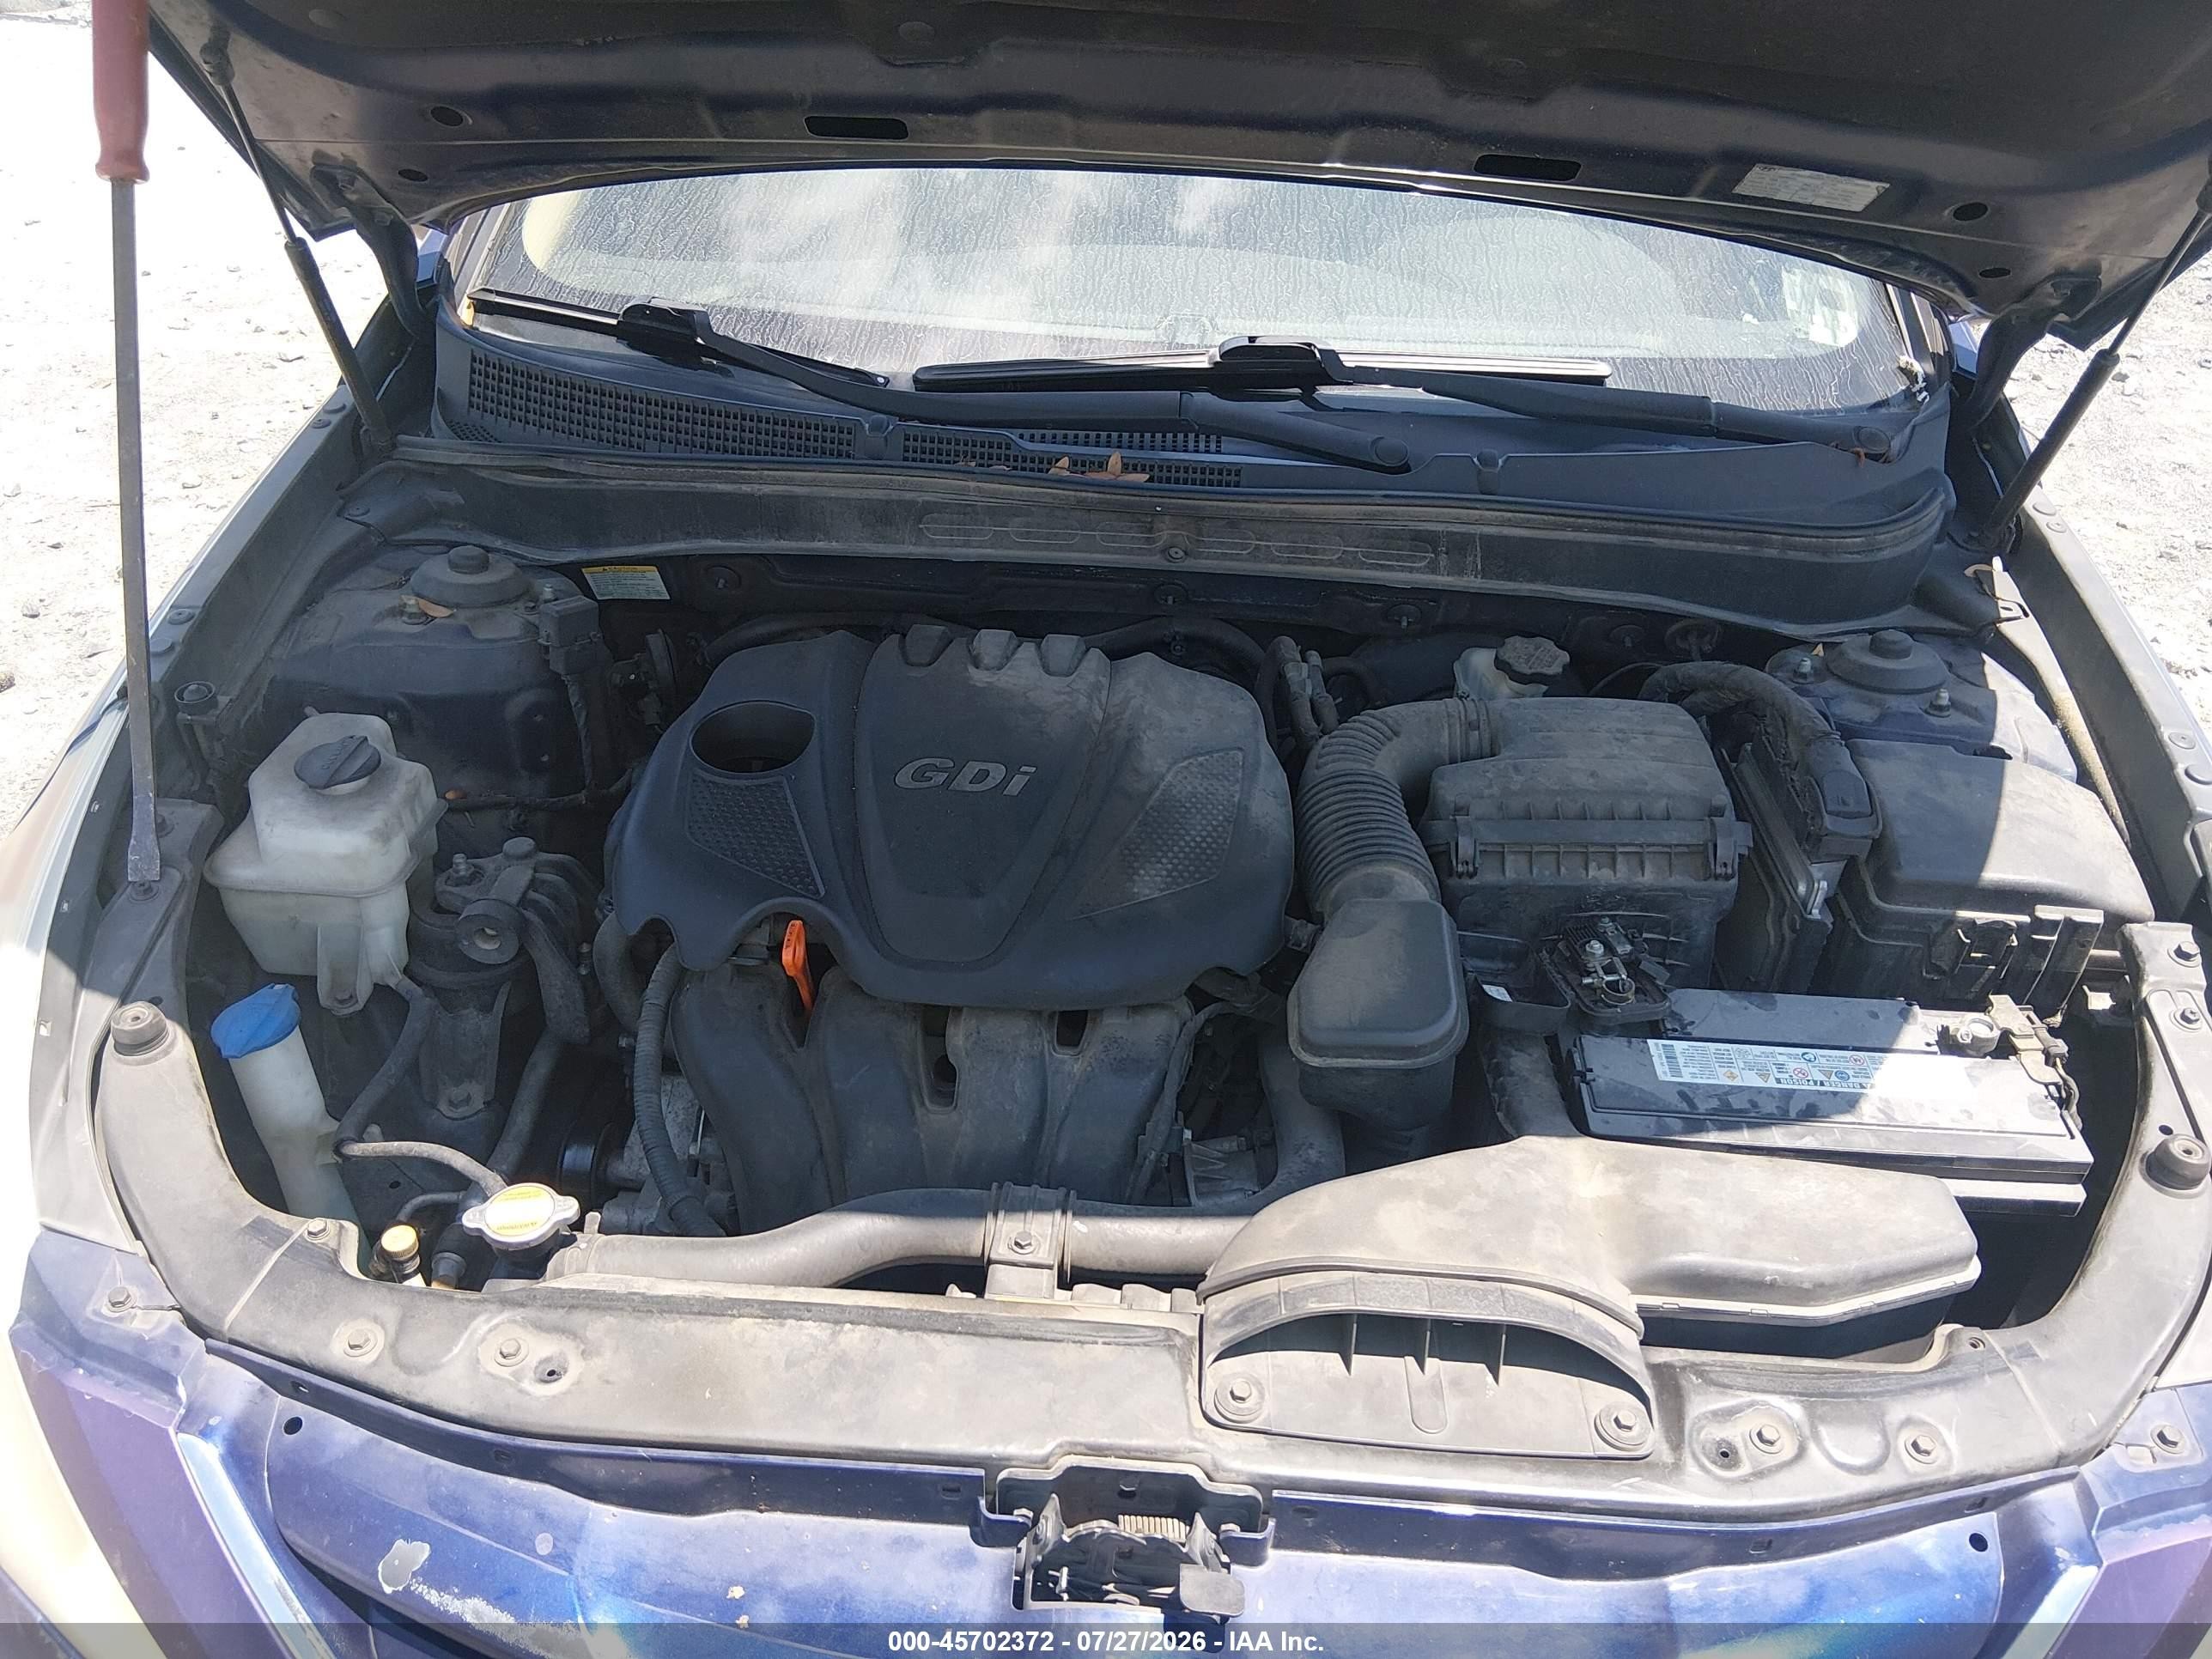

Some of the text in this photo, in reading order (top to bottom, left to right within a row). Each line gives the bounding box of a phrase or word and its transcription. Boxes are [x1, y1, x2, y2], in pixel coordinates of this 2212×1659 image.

[895, 757, 1036, 796] GDi
[1780, 1078, 1814, 1086] POISON
[1823, 1079, 1861, 1089] DANGER
